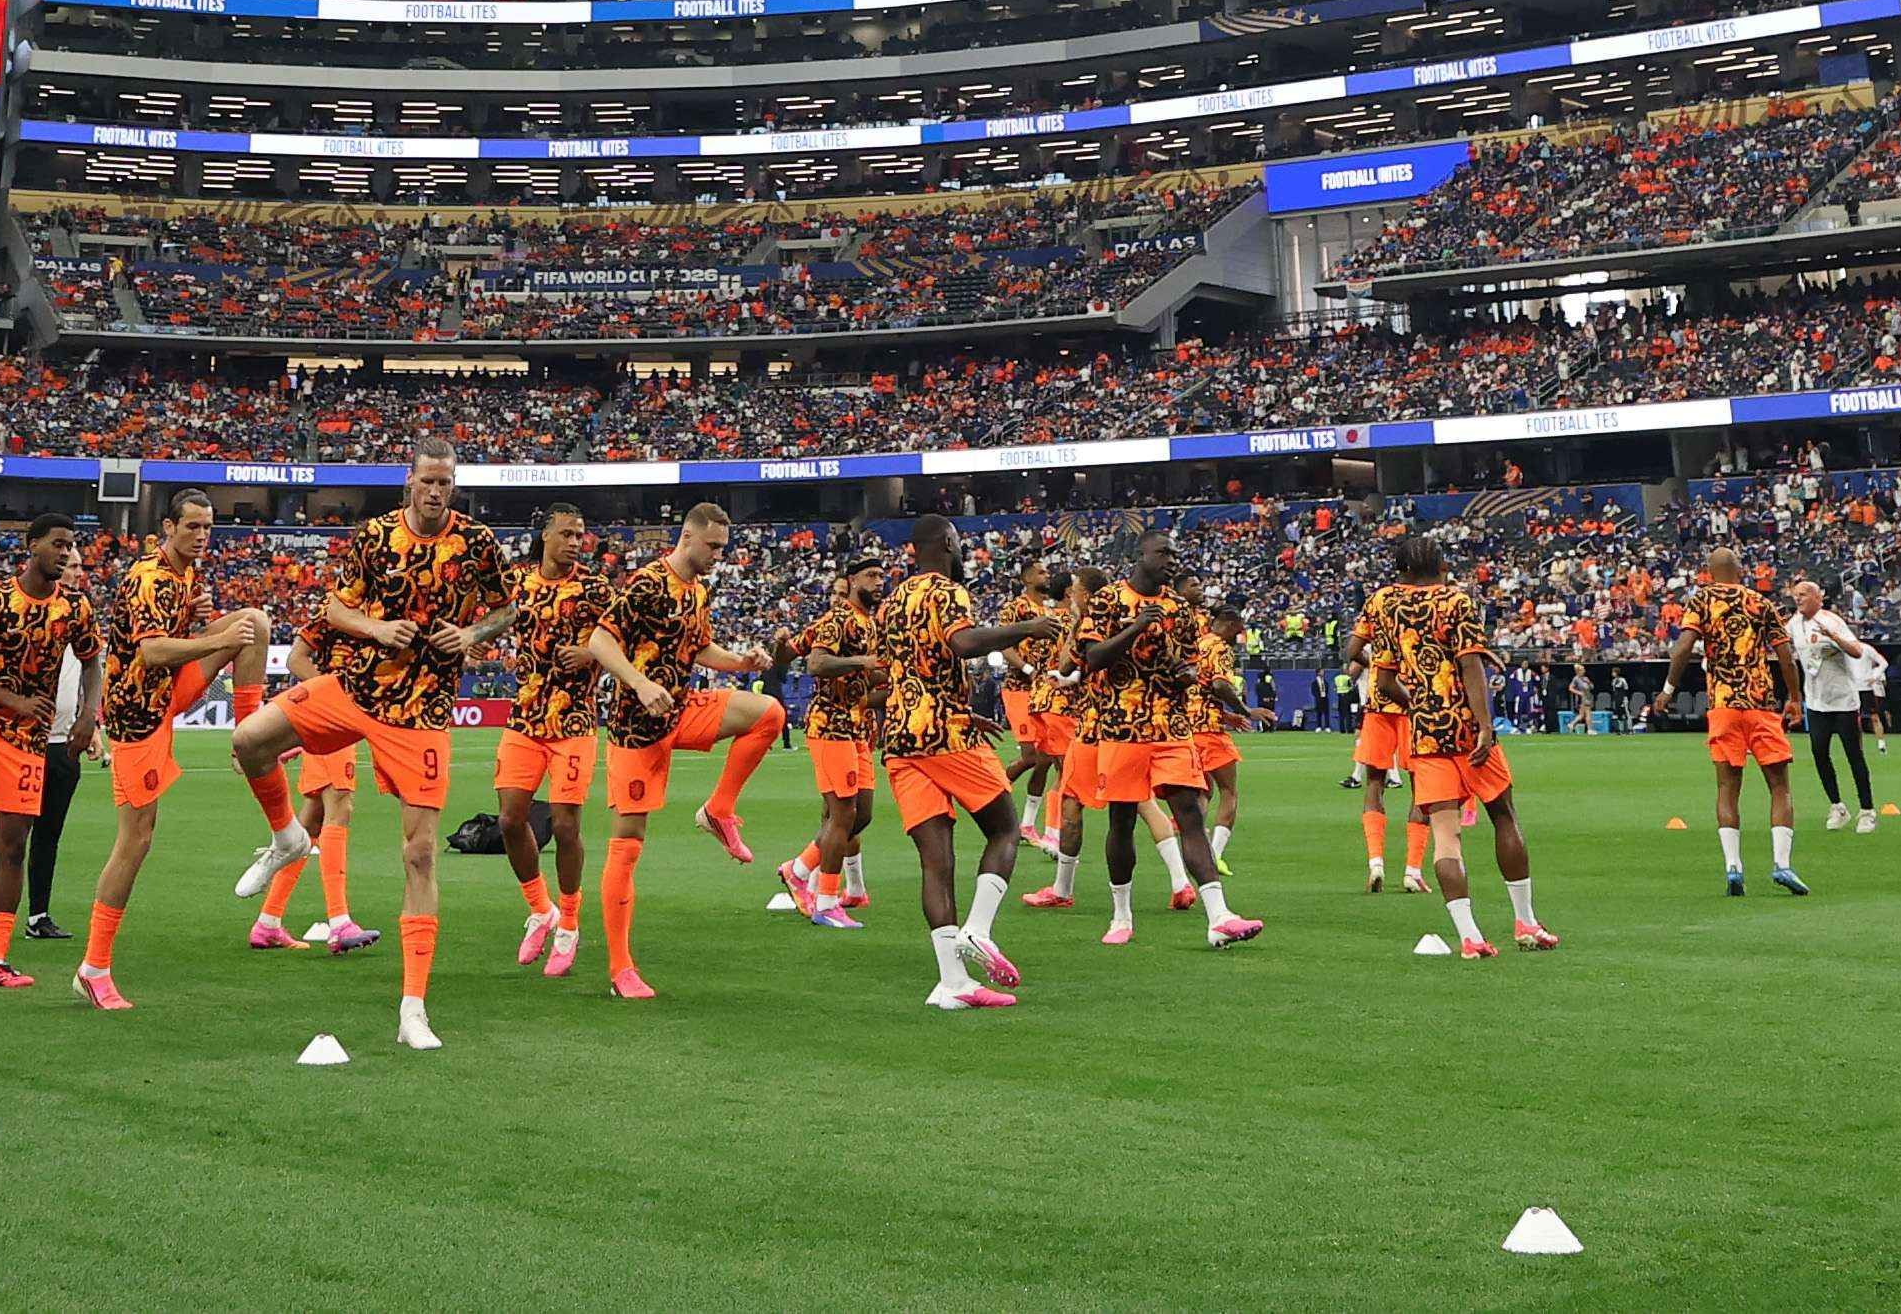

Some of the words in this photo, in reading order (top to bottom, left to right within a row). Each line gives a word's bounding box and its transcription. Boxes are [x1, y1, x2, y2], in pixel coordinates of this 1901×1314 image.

[534, 272, 568, 284] FIFA
[571, 271, 627, 283] WORLD
[423, 748, 439, 781] 9
[567, 755, 581, 782] 5
